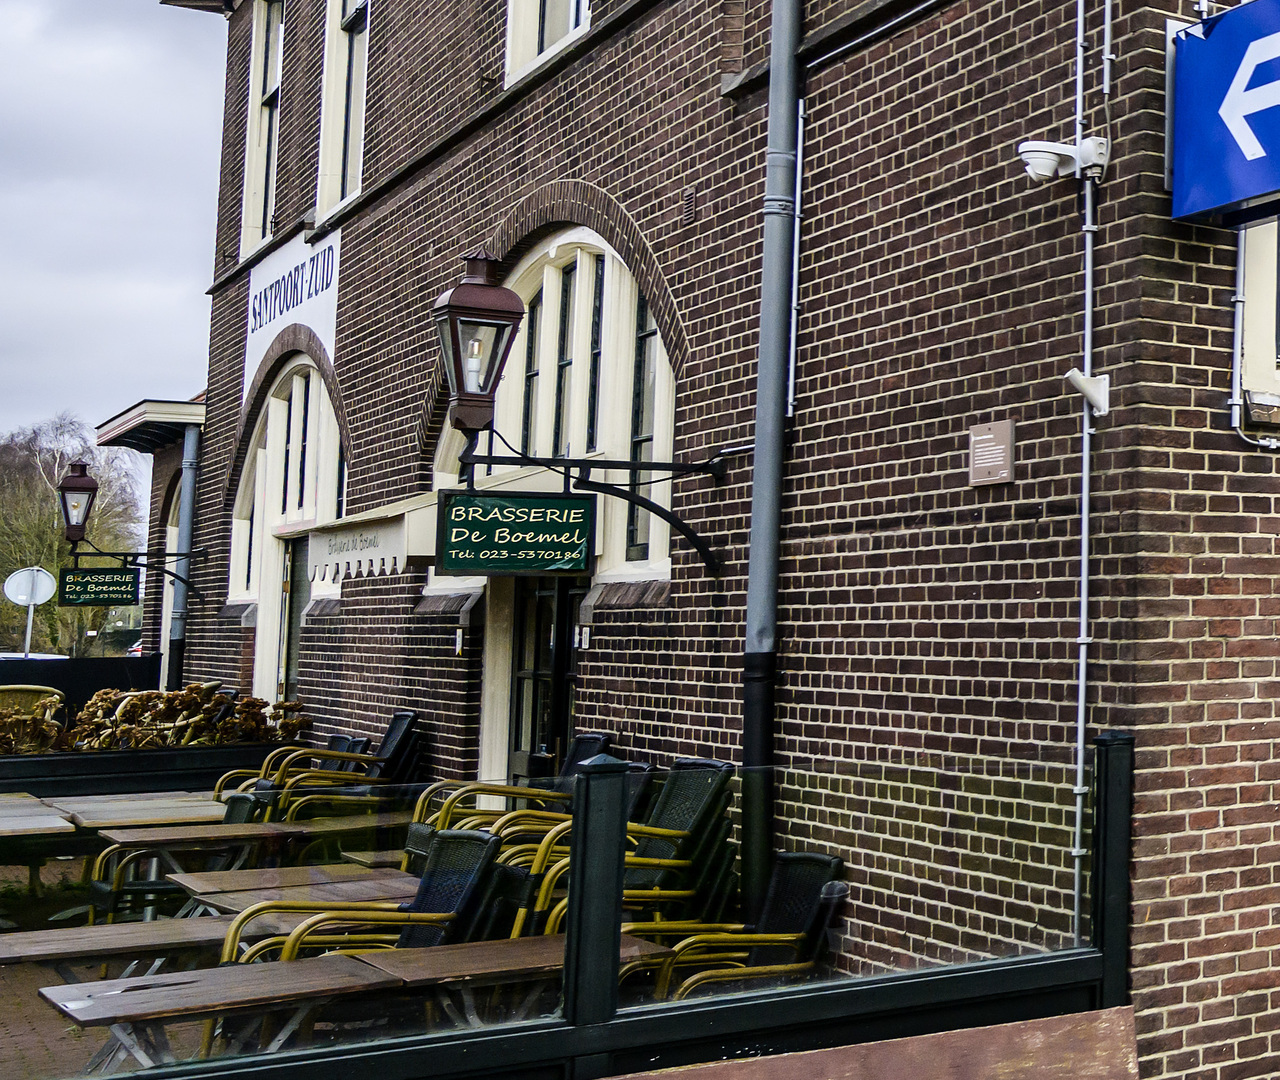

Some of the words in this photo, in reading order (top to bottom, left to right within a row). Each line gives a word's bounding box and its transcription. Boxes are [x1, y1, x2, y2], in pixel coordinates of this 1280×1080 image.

[451, 506, 585, 523] BRASSERIE
[451, 528, 487, 543] De
[494, 528, 586, 544] Boemel
[449, 549, 475, 559] Tel:
[479, 549, 582, 560] 023-5370186
[65, 574, 134, 582] BRASSERIE
[65, 584, 84, 592] De
[87, 583, 135, 592] Boemel
